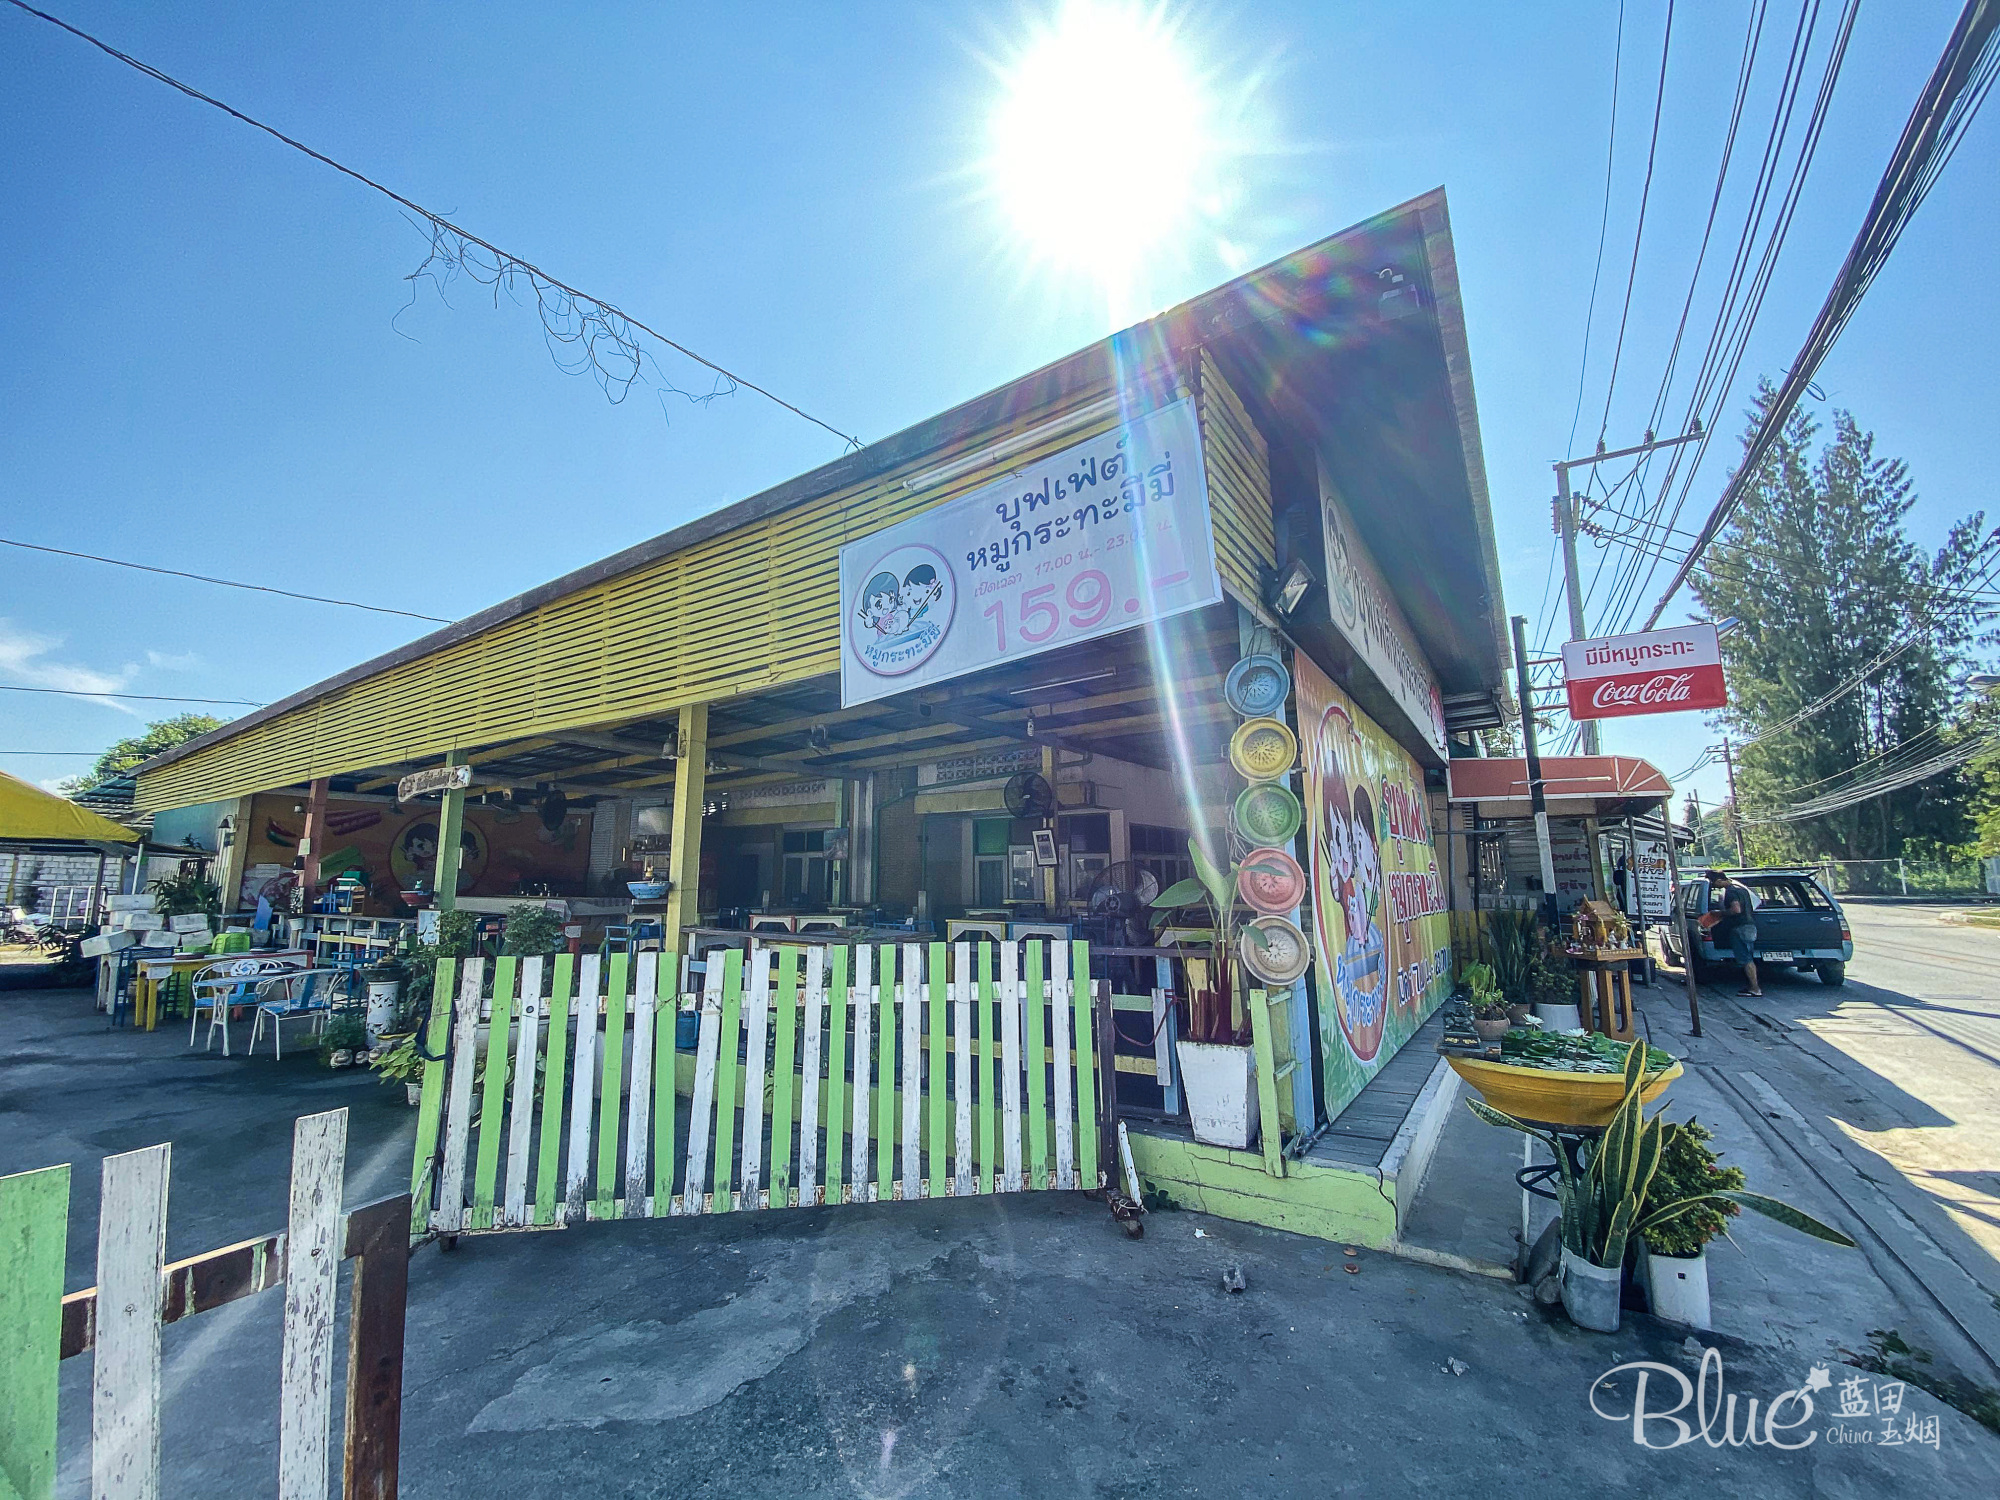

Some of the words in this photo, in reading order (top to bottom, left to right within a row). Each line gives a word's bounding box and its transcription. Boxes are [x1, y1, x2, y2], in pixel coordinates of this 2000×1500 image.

[966, 451, 1176, 574] หมูกระทะมีมี่
[974, 572, 1022, 598] เปิดเวลา
[1585, 640, 1695, 667] มีมี่หมูกระทะ
[1592, 672, 1695, 709] Coca-Cola
